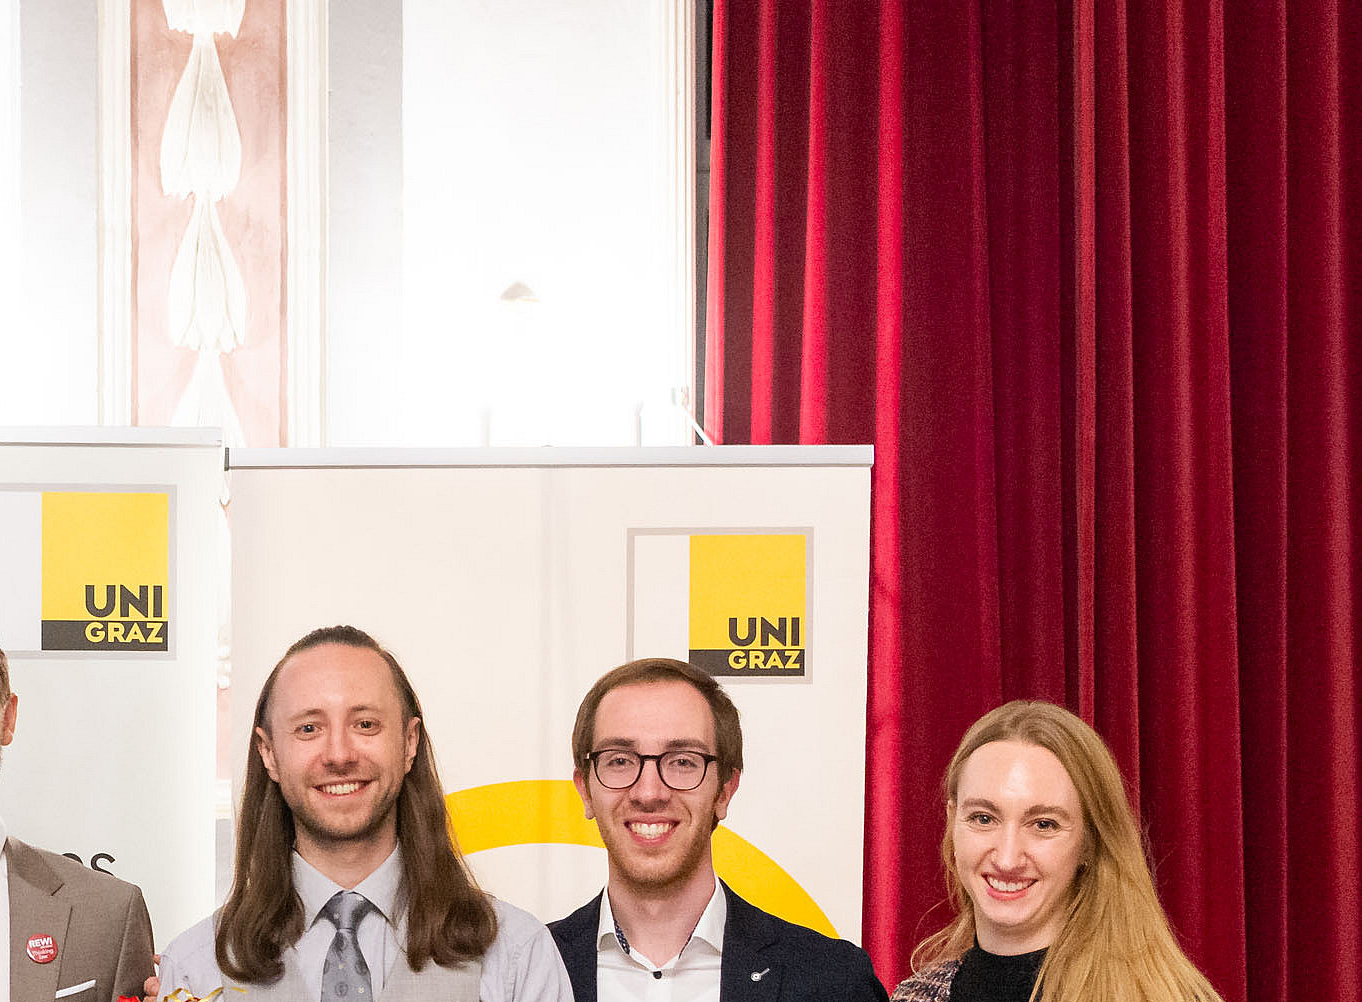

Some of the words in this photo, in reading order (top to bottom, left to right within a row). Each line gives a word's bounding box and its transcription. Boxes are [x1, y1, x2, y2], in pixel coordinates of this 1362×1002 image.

[85, 584, 163, 618] UNI
[85, 622, 163, 643] GRAZ
[728, 617, 800, 647] UNI
[728, 650, 800, 669] GRAZ
[28, 937, 53, 948] REWI
